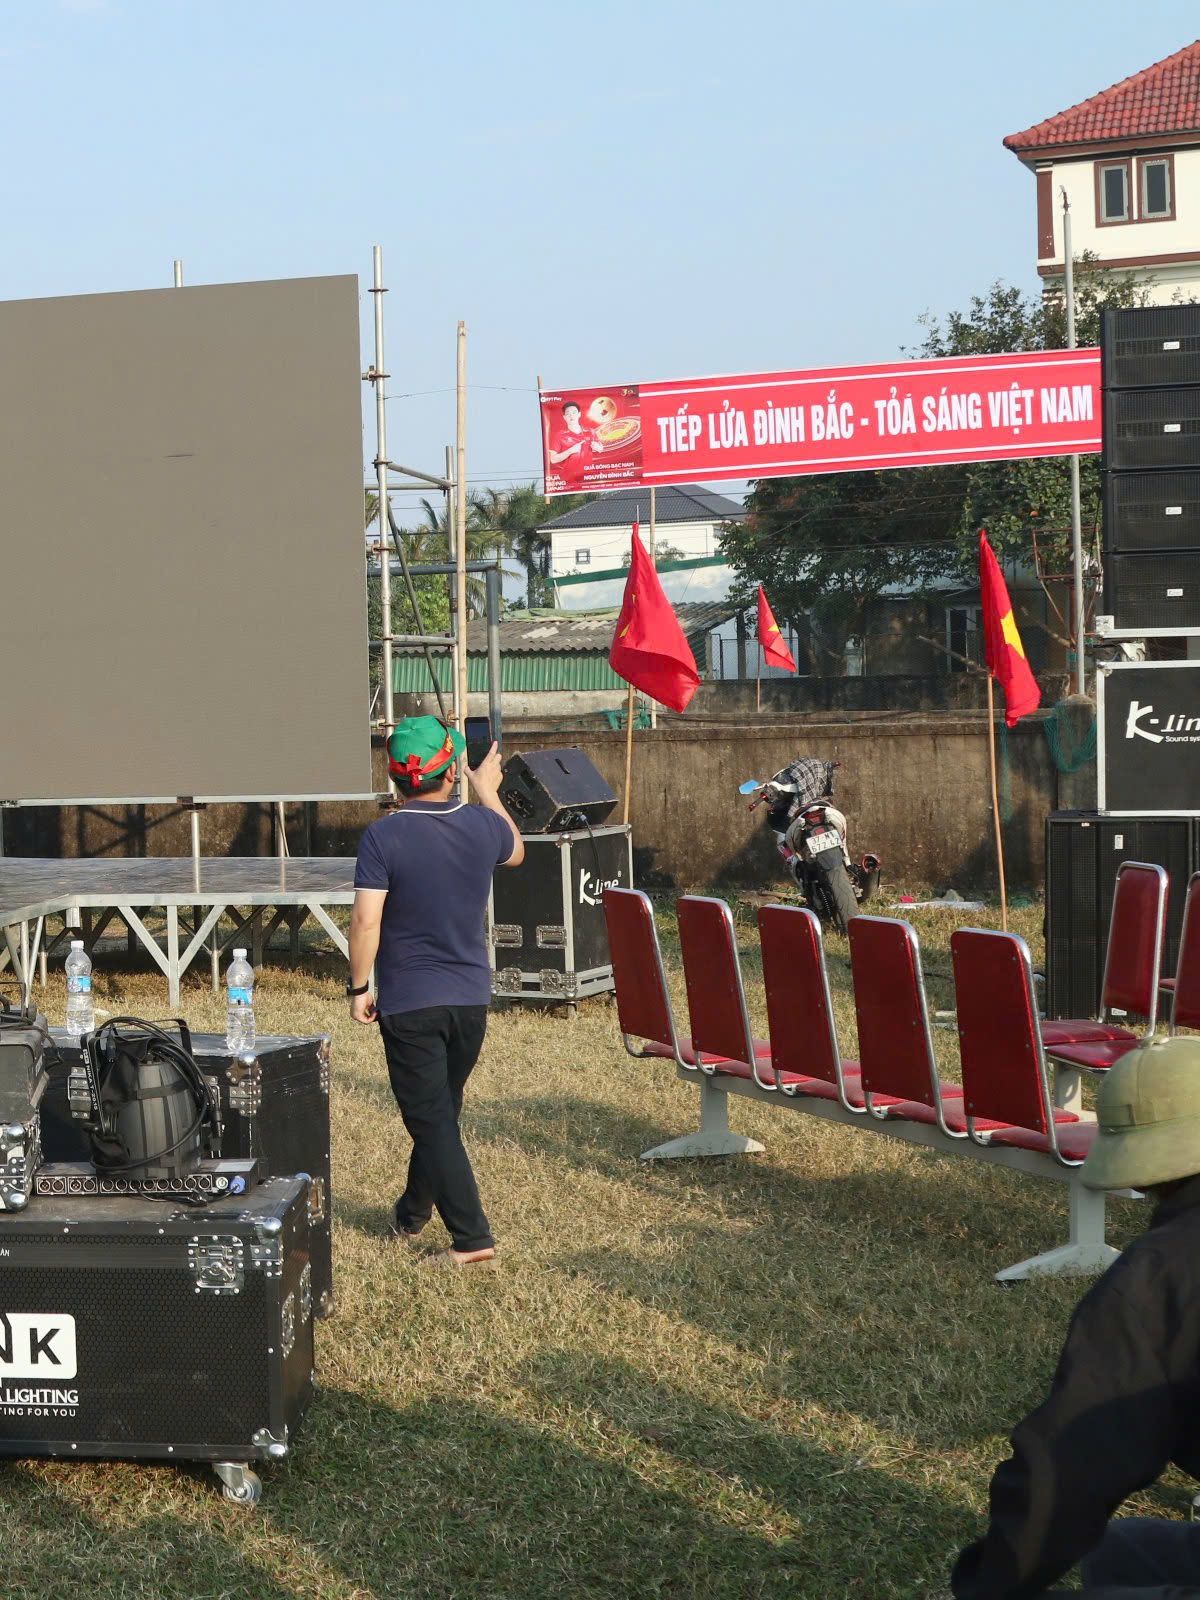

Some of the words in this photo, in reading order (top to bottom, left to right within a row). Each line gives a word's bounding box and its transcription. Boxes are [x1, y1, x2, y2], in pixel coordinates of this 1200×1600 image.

[657, 403, 702, 453] TIẾP
[708, 399, 749, 449] LỬA
[753, 400, 806, 446] ĐÌNH
[810, 389, 854, 442] BẮC
[859, 417, 870, 427] -
[922, 386, 982, 433] SÁNG
[987, 382, 1035, 434] VIỆT
[1040, 384, 1094, 424] NAM
[5, 1388, 79, 1404] LIGHTING
[27, 1407, 50, 1417] FOR
[52, 1408, 77, 1418] YOU
